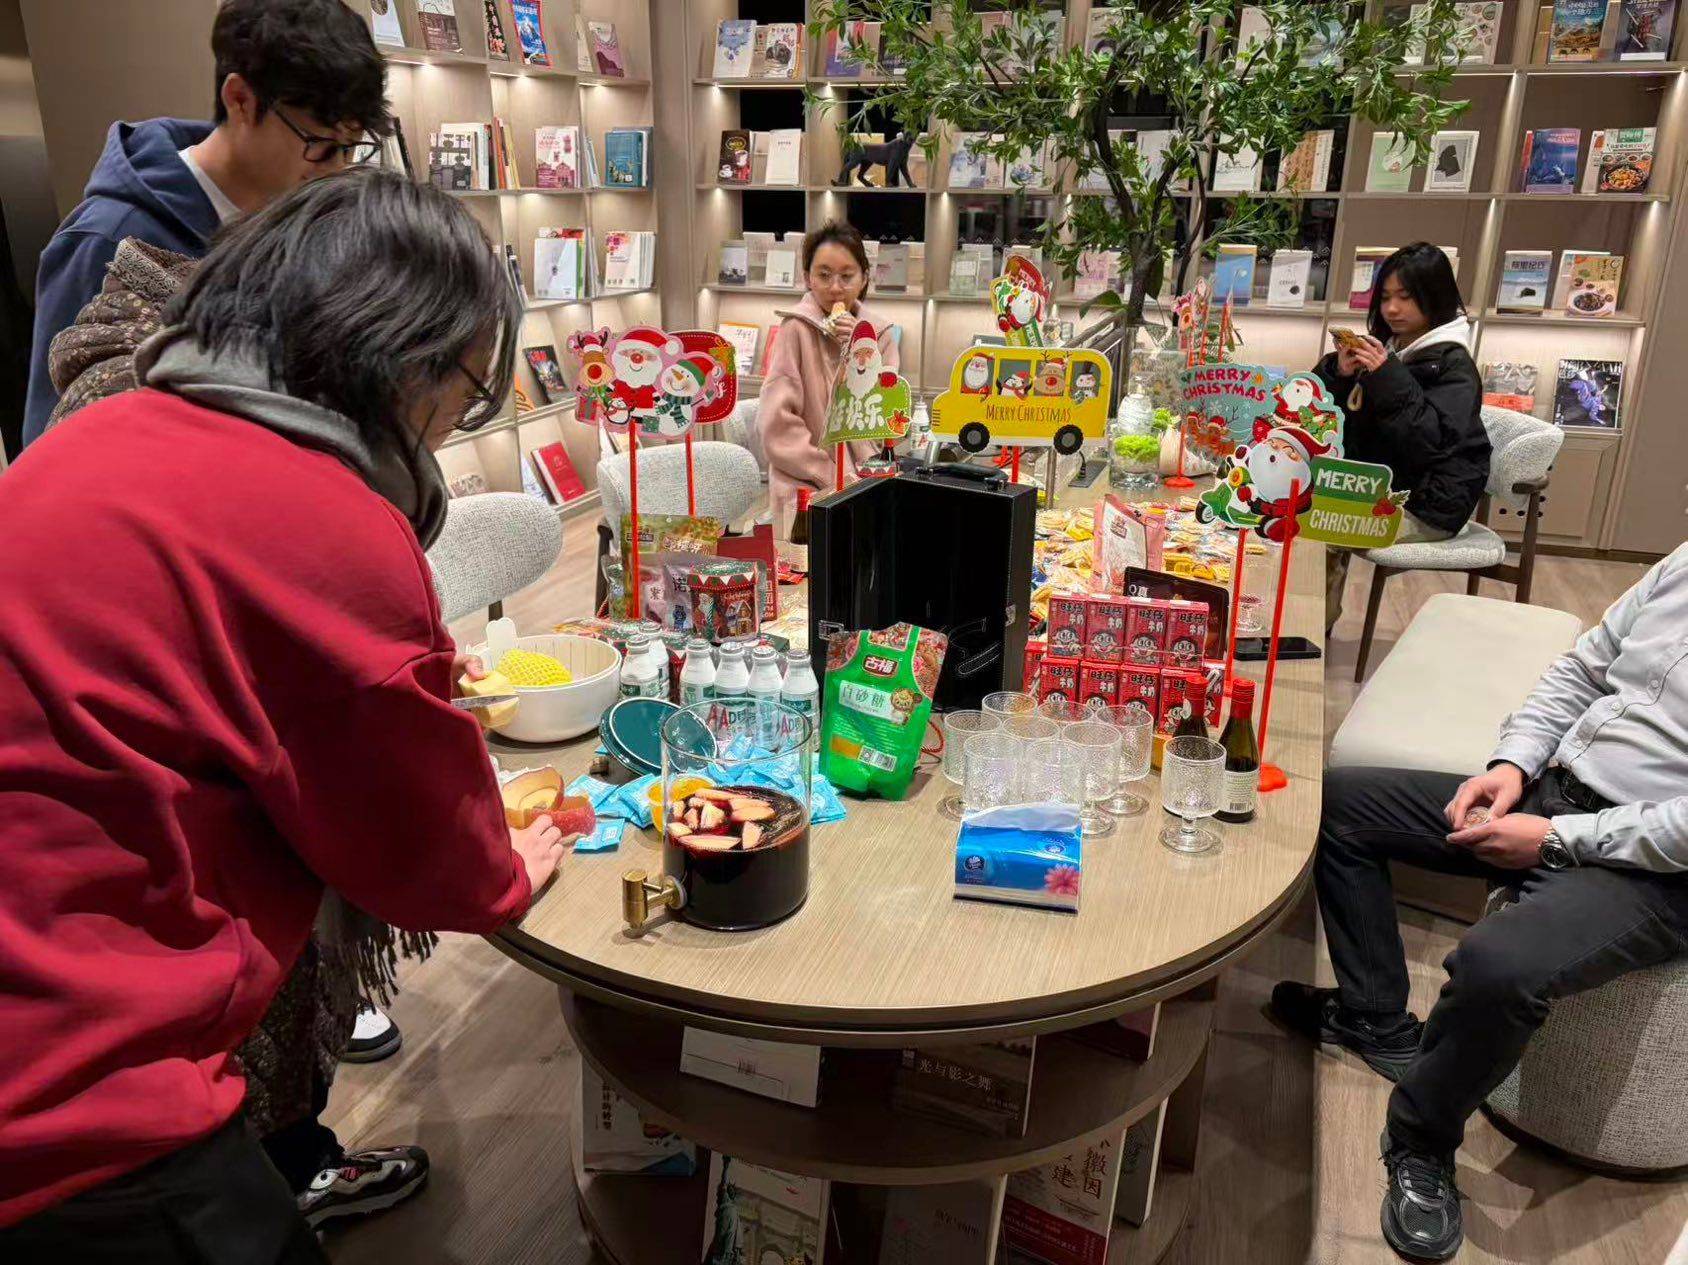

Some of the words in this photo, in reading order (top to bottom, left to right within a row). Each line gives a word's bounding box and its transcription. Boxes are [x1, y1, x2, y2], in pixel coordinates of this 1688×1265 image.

[1194, 368, 1252, 383] MERRY
[1183, 382, 1267, 403] CHRISTMAS
[985, 404, 1016, 422] MERRY
[1017, 405, 1072, 423] CHRISTMAS
[1316, 467, 1383, 495] MERRY
[1308, 509, 1390, 538] CHRISTMAS
[1083, 1140, 1111, 1199] 徽因
